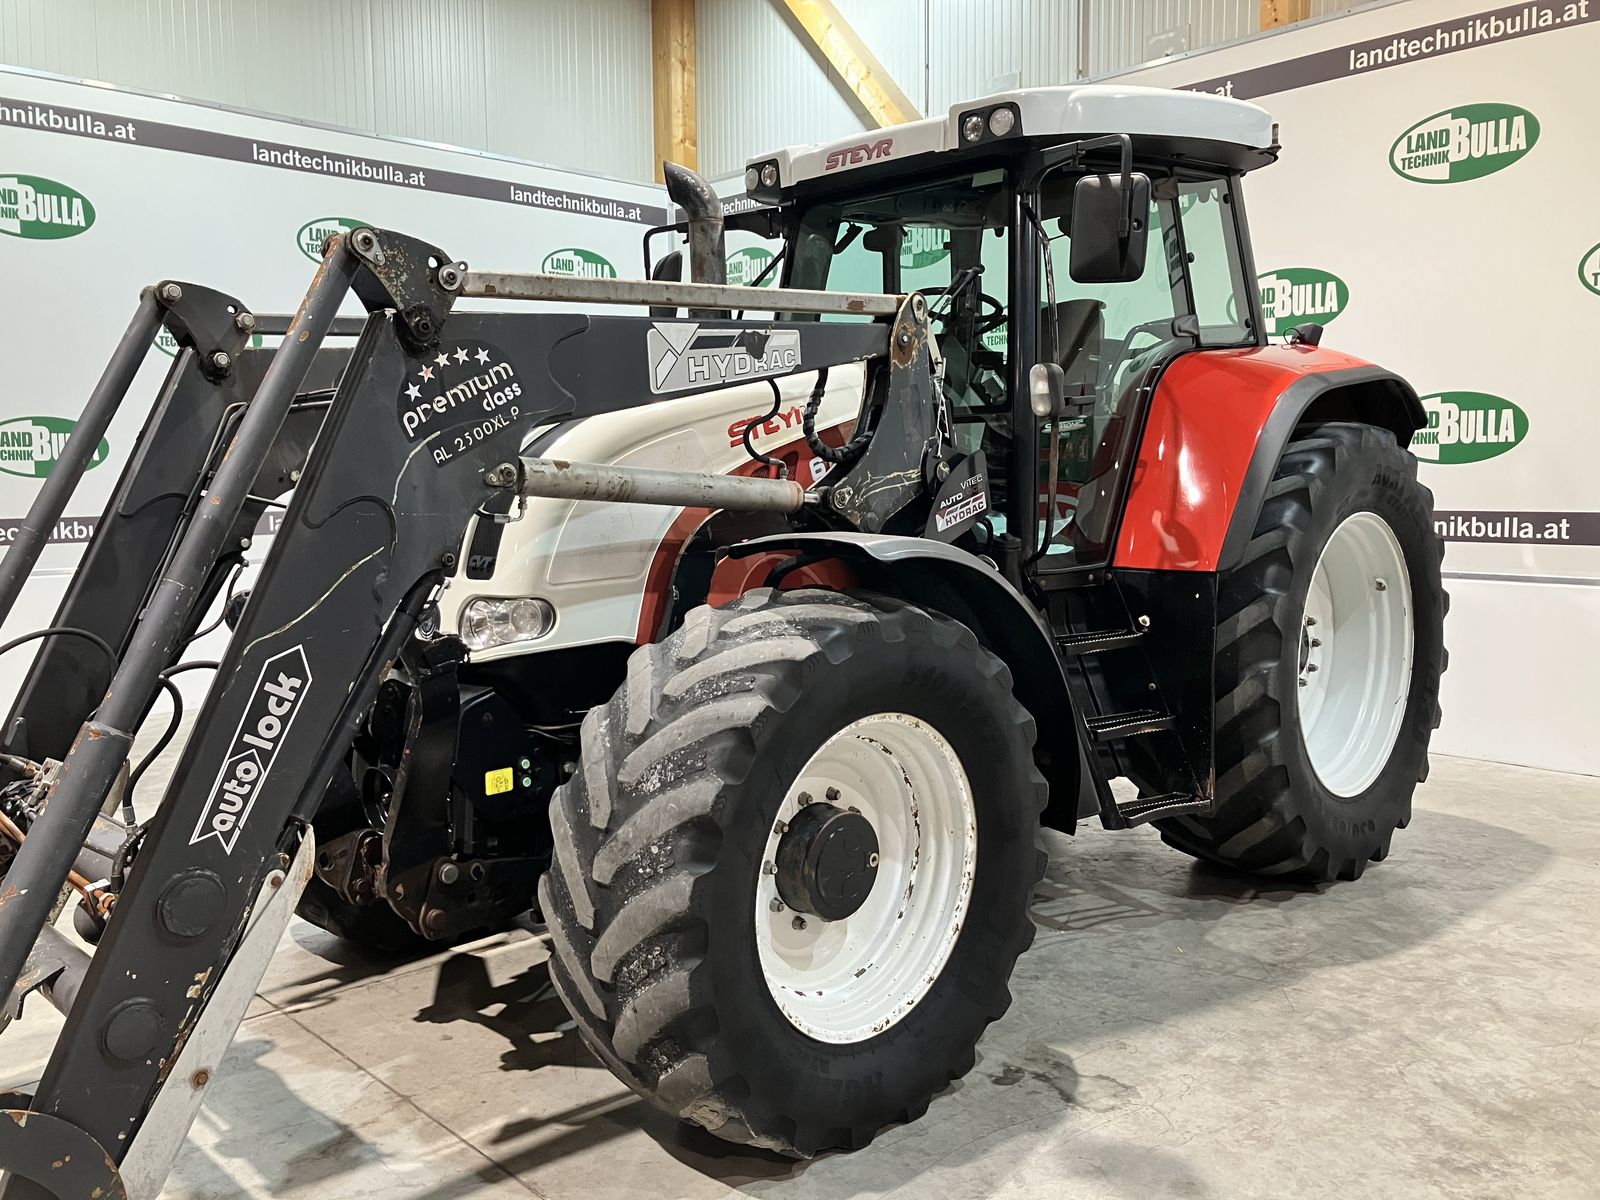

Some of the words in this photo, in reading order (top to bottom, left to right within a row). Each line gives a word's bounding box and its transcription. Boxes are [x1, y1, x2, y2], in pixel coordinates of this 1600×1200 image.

[1349, 0, 1589, 70] landtechnikbulla.at
[825, 138, 893, 170] STEYR
[1406, 128, 1450, 154] LAND
[252, 143, 426, 187] landtechnikbulla.at
[1400, 150, 1450, 171] TECHNIK
[511, 186, 641, 221] landtechnikbulla.at
[551, 257, 574, 272] LAND
[687, 348, 796, 383] HYDRAC
[402, 362, 514, 437] premium
[483, 381, 522, 411] class
[433, 447, 452, 464] AL
[940, 492, 963, 509] AUTO
[945, 501, 984, 527] HYDRAC
[212, 760, 259, 832] auto
[242, 672, 302, 751] lock
